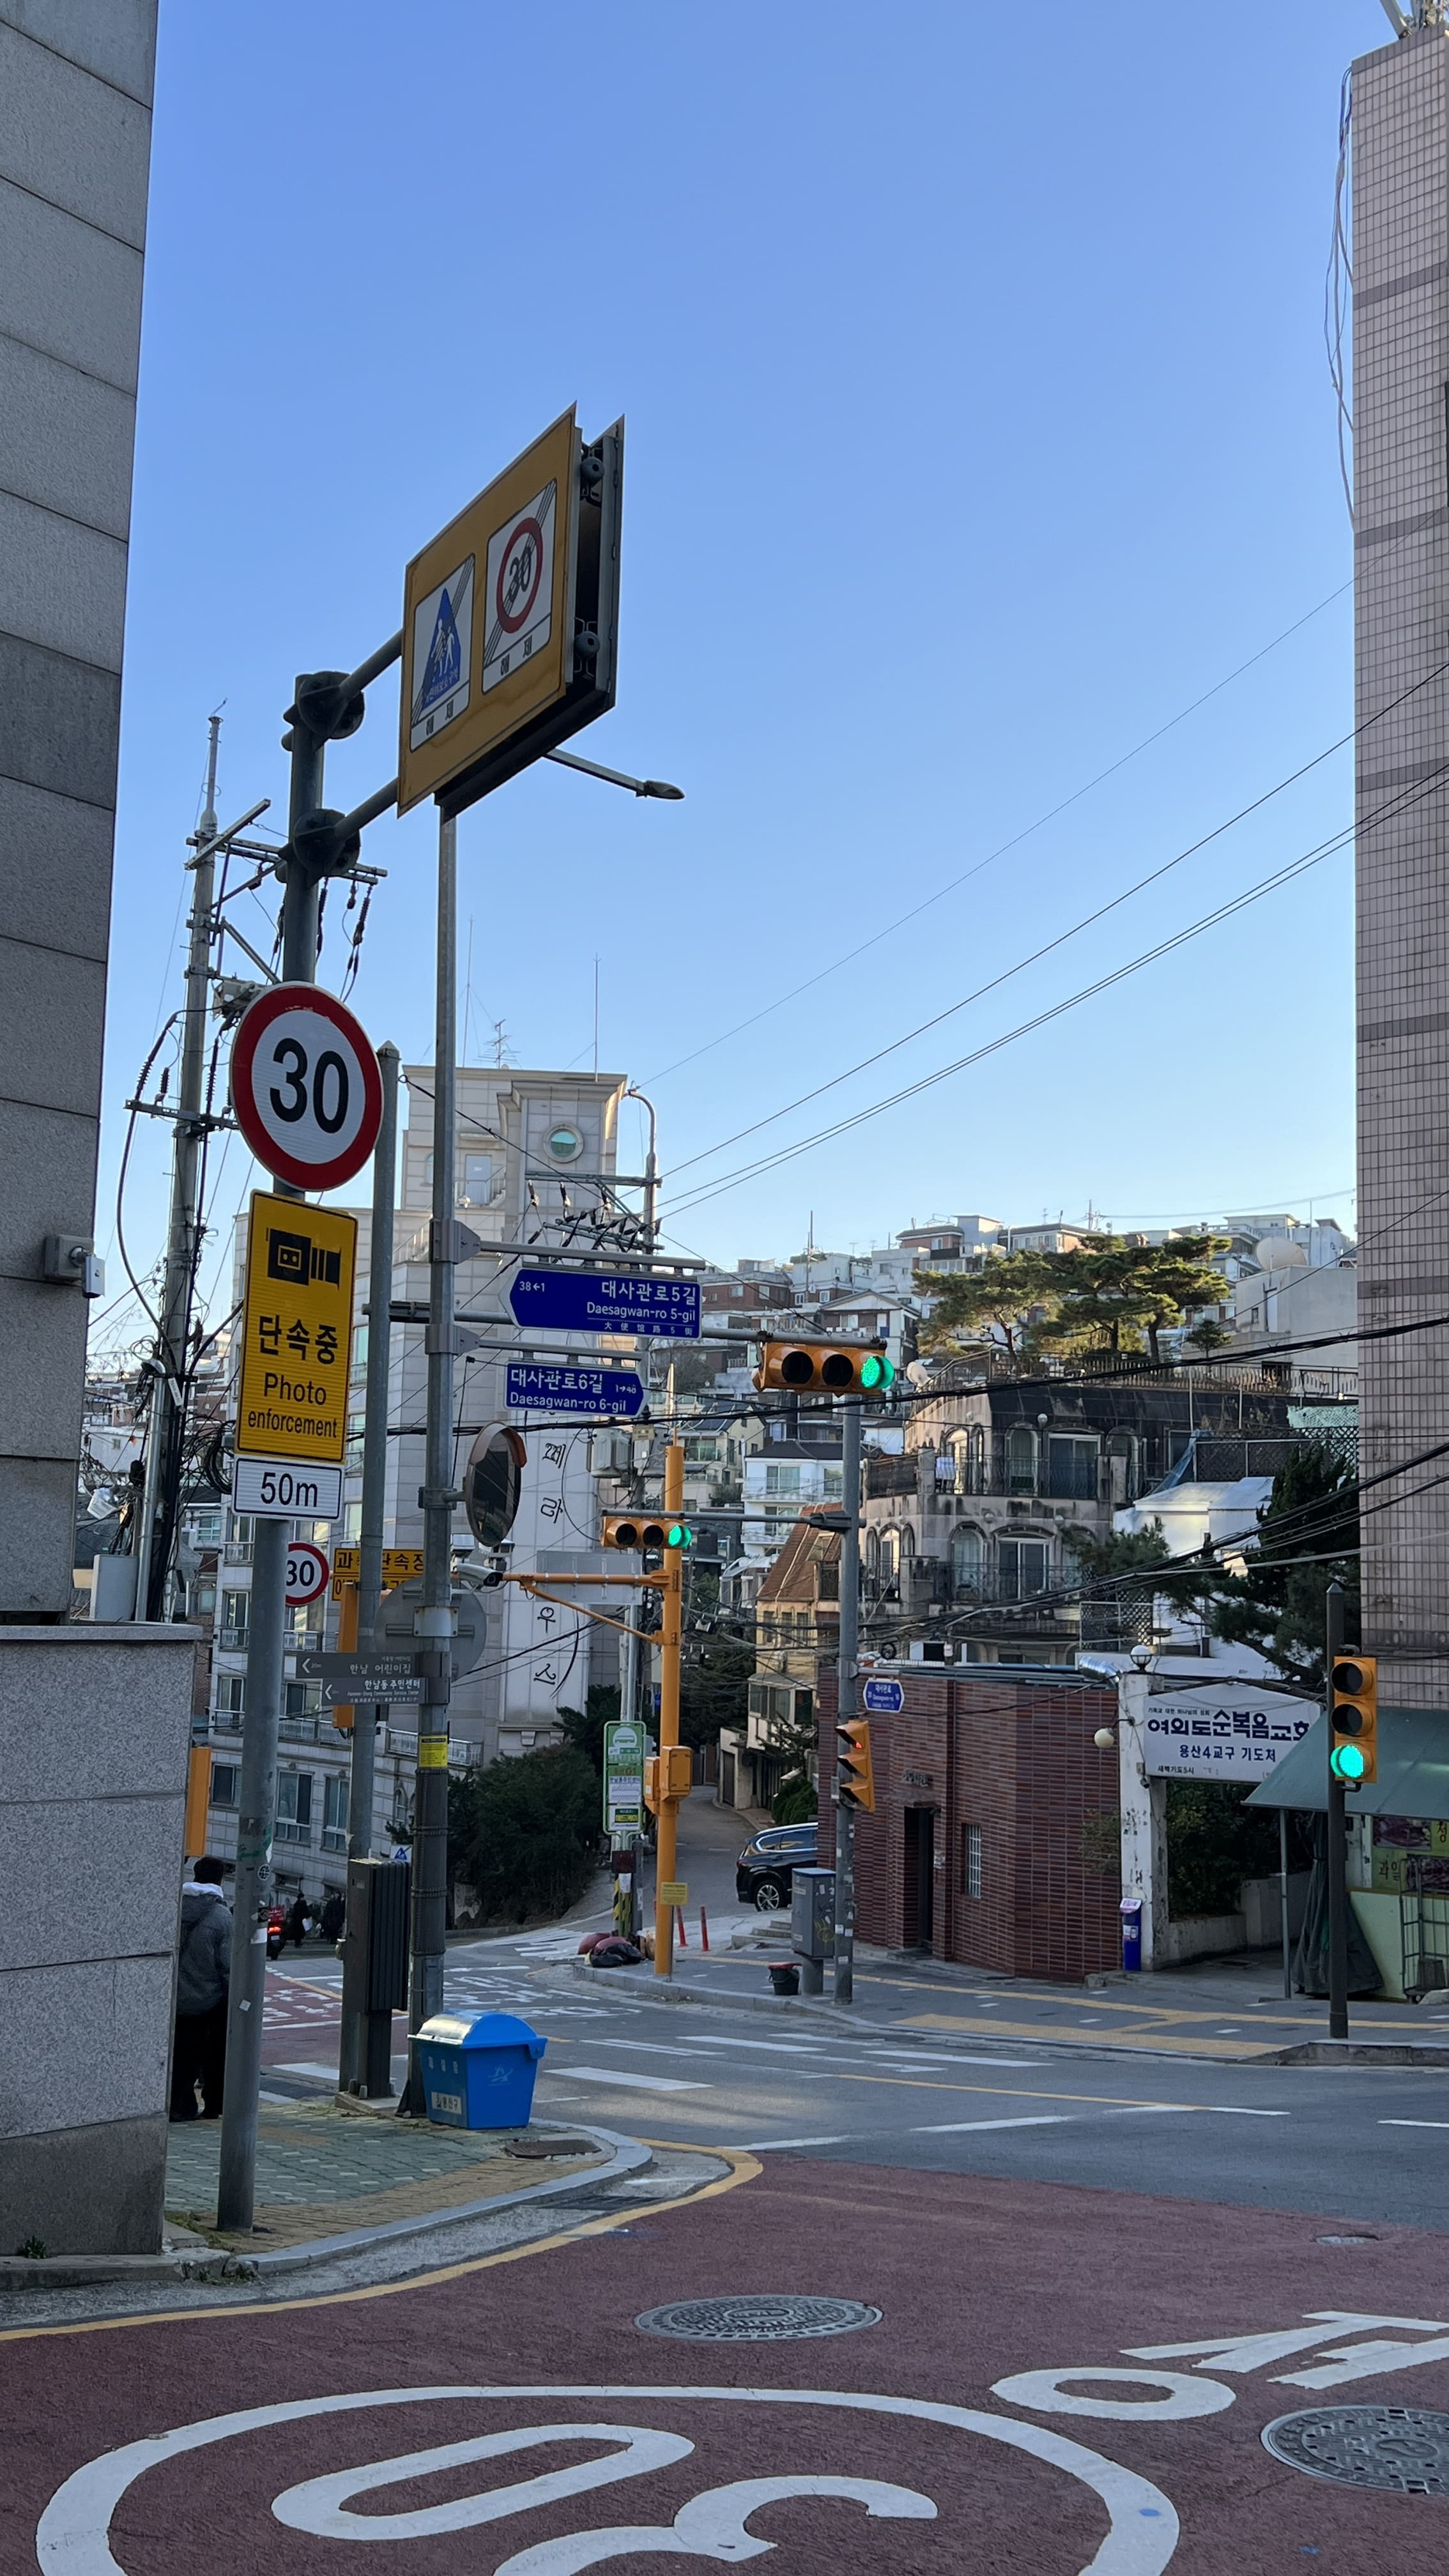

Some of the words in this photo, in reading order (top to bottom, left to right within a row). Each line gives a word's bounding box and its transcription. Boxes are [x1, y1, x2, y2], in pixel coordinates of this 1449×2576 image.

[269, 1037, 349, 1135] 30
[601, 1280, 696, 1306] 대사관로5길
[586, 1301, 667, 1319] Daesagwan-ro
[670, 1308, 696, 1322] 5-gil
[259, 1314, 339, 1365] 단속중
[263, 1372, 326, 1406] Photo
[510, 1368, 603, 1395] 대사관로6길
[510, 1392, 597, 1409] Daesagwan-ro
[599, 1398, 627, 1413] 6-gil
[247, 1408, 337, 1439] enforcement
[260, 1471, 318, 1508] 50m
[286, 1560, 315, 1586] 30
[374, 1663, 411, 1675] 어린이집
[364, 1679, 388, 1690] 한남동
[390, 1678, 420, 1690] 주민센터
[1179, 1744, 1236, 1760] 용산4교구
[1241, 1747, 1276, 1763] 기도처
